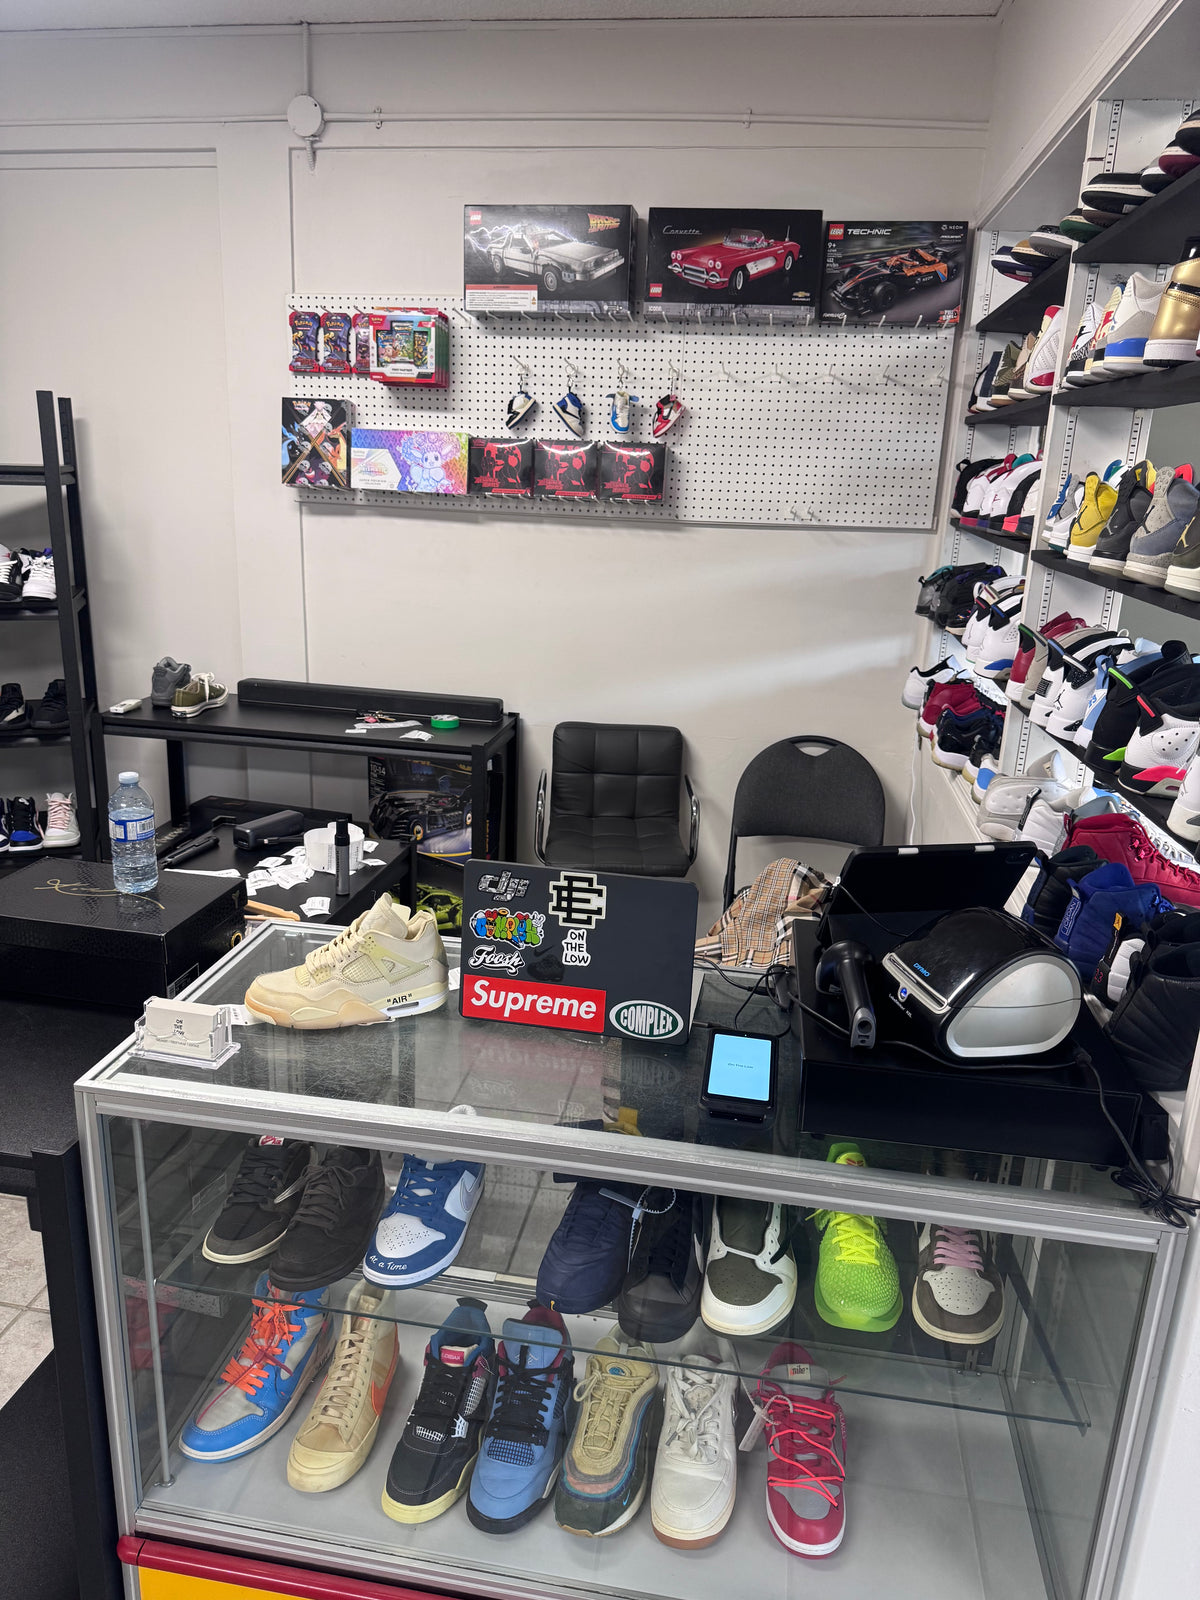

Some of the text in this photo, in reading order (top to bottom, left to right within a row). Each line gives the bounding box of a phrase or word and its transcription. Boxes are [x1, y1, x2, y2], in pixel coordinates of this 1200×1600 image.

[662, 225, 703, 235] Corvette
[829, 228, 892, 236] LEGO TECHNIC
[569, 931, 585, 941] ON
[564, 942, 585, 953] THE
[468, 945, 525, 976] Foosh
[564, 953, 590, 965] LOW
[913, 962, 931, 977] DYMO
[470, 979, 597, 1020] Supreme
[619, 1004, 674, 1036] COMPLEX
[386, 1261, 408, 1271] Time
